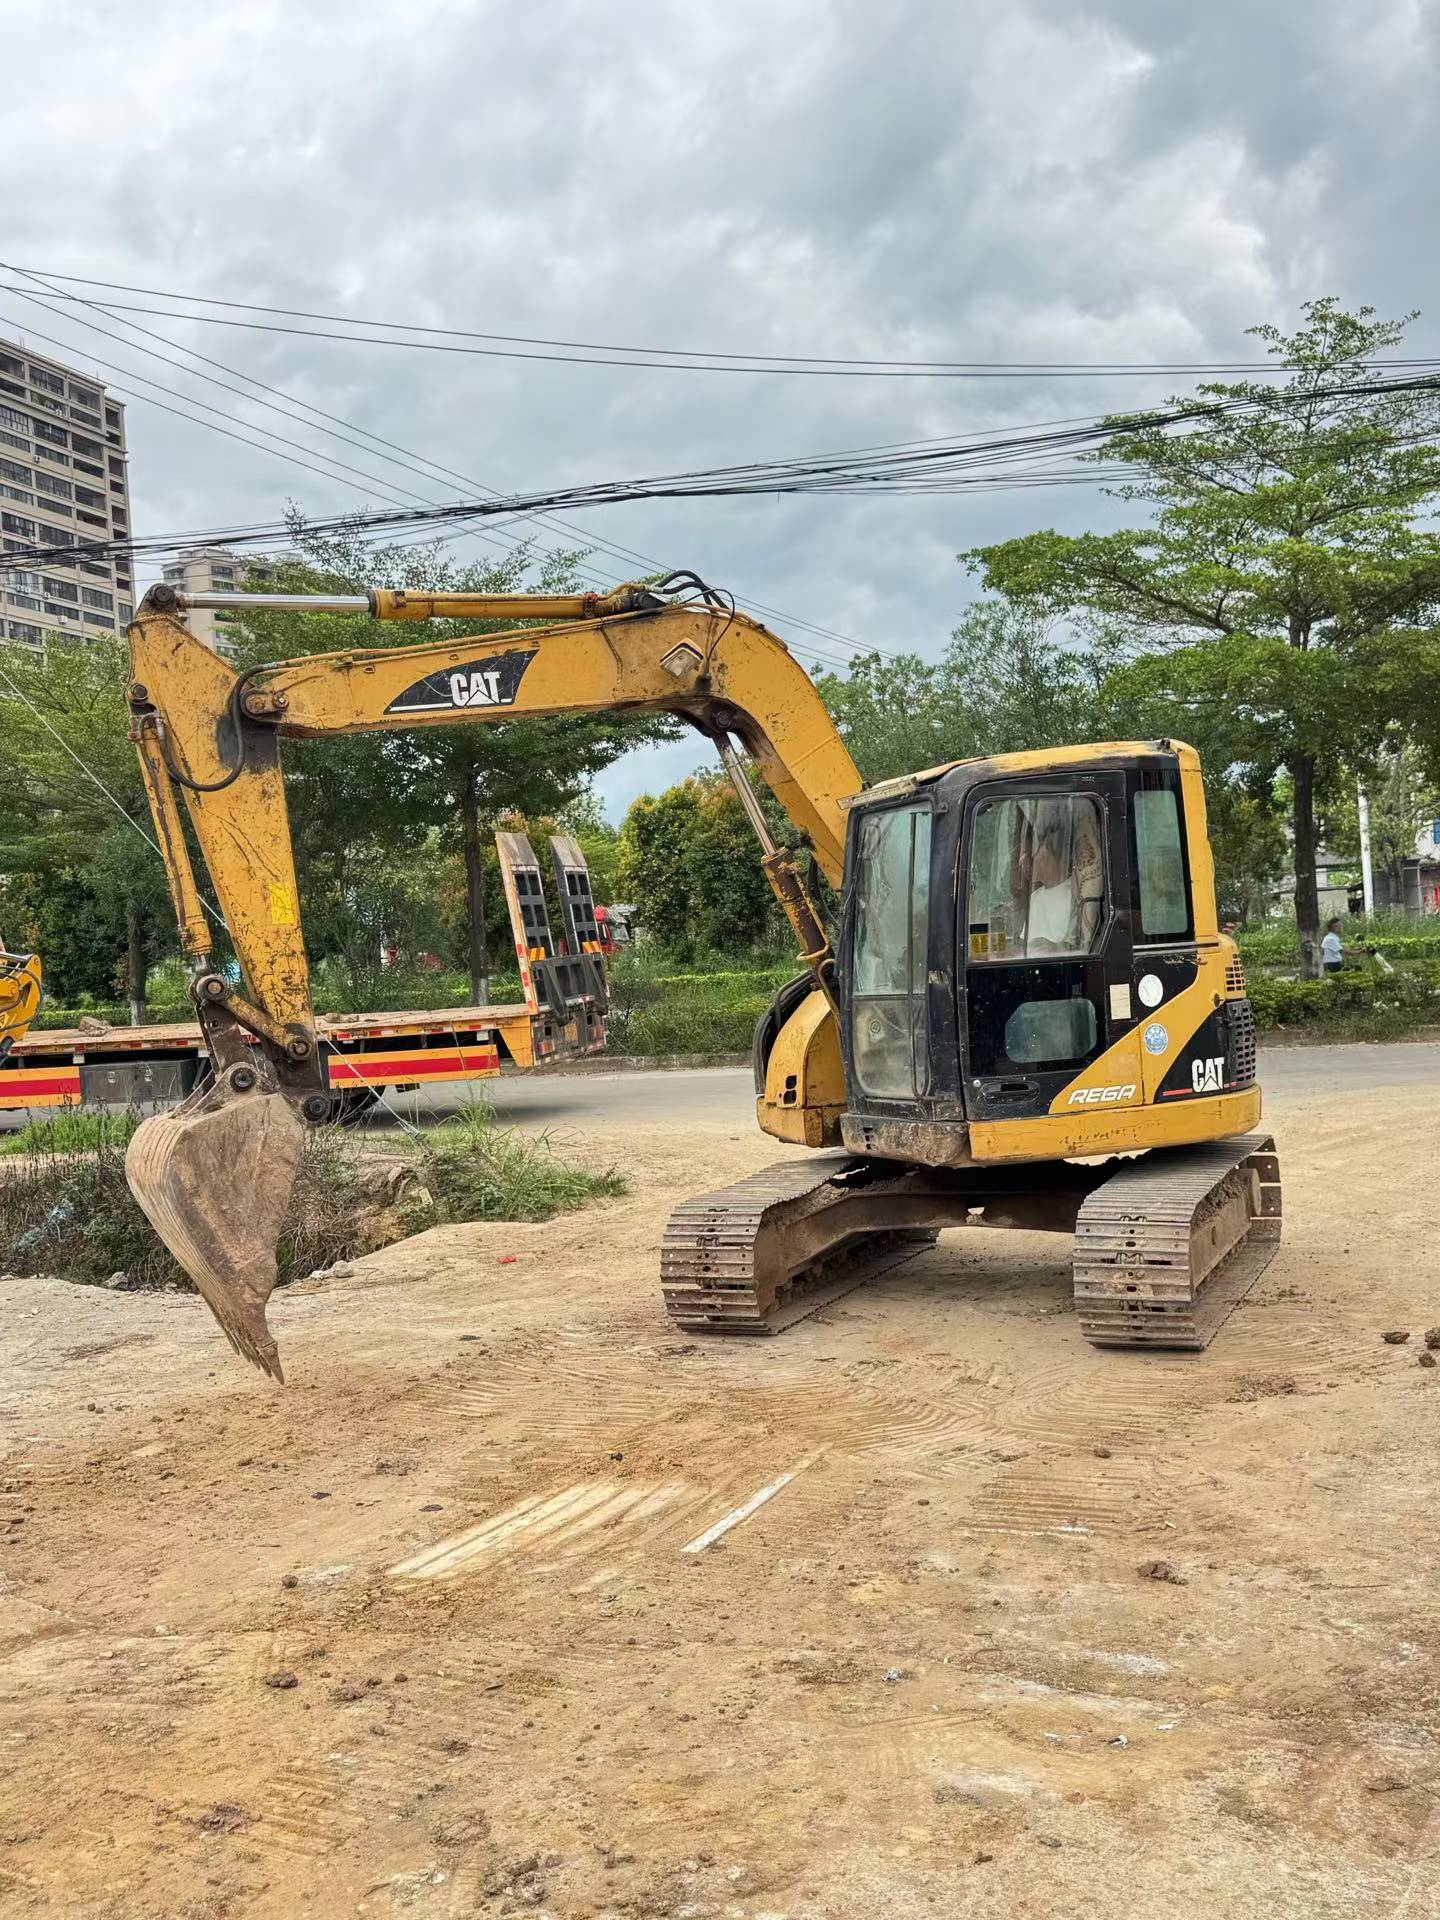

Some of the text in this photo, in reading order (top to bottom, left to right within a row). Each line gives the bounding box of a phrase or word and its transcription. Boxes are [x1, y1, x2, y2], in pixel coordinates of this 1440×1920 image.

[449, 671, 500, 707] CAT
[1192, 1057, 1225, 1093] CAT
[1068, 1084, 1137, 1105] REGA
